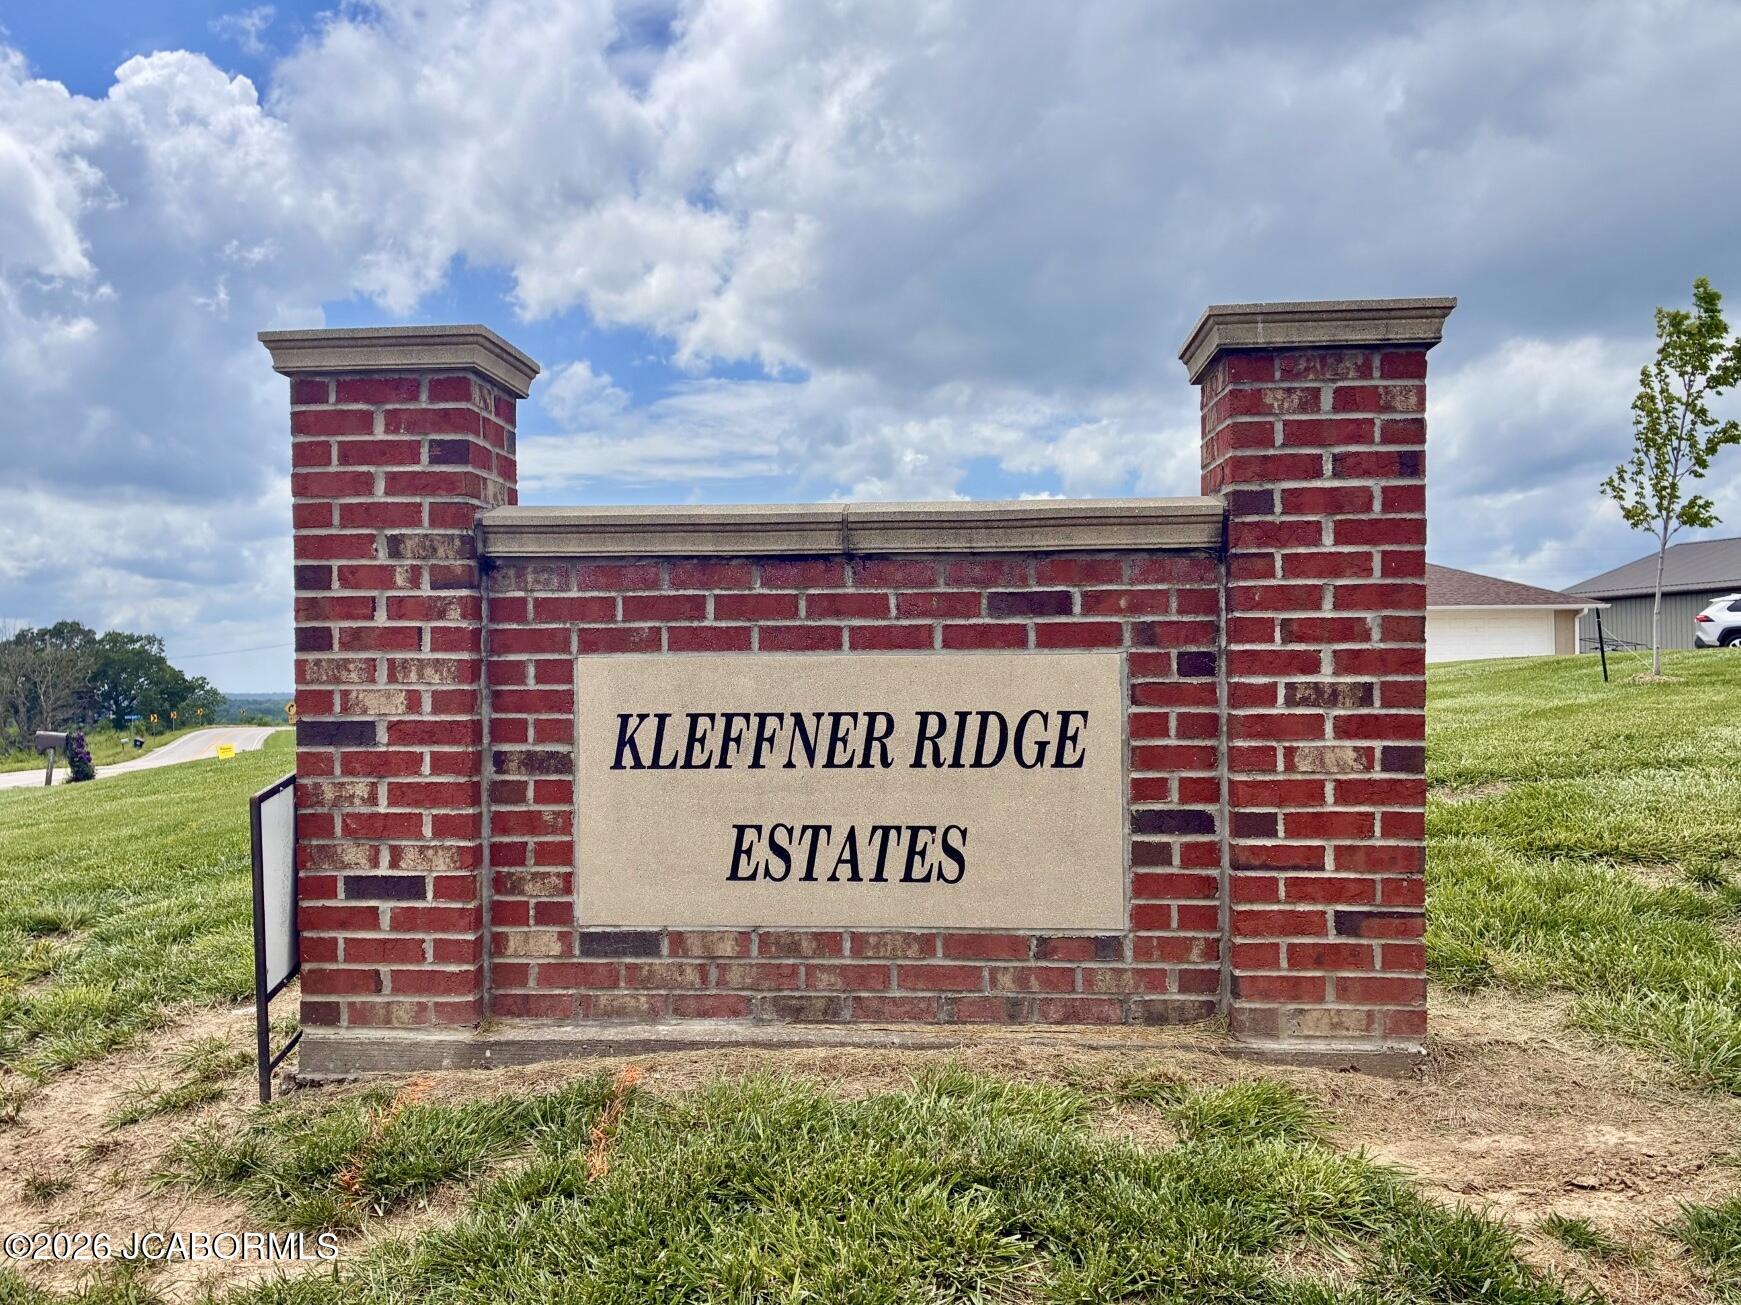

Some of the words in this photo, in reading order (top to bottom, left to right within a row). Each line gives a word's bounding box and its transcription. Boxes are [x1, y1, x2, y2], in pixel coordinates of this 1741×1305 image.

[609, 711, 895, 770] KLEFFNER
[908, 709, 1089, 770] RIDGE
[725, 823, 968, 884] ESTATES
